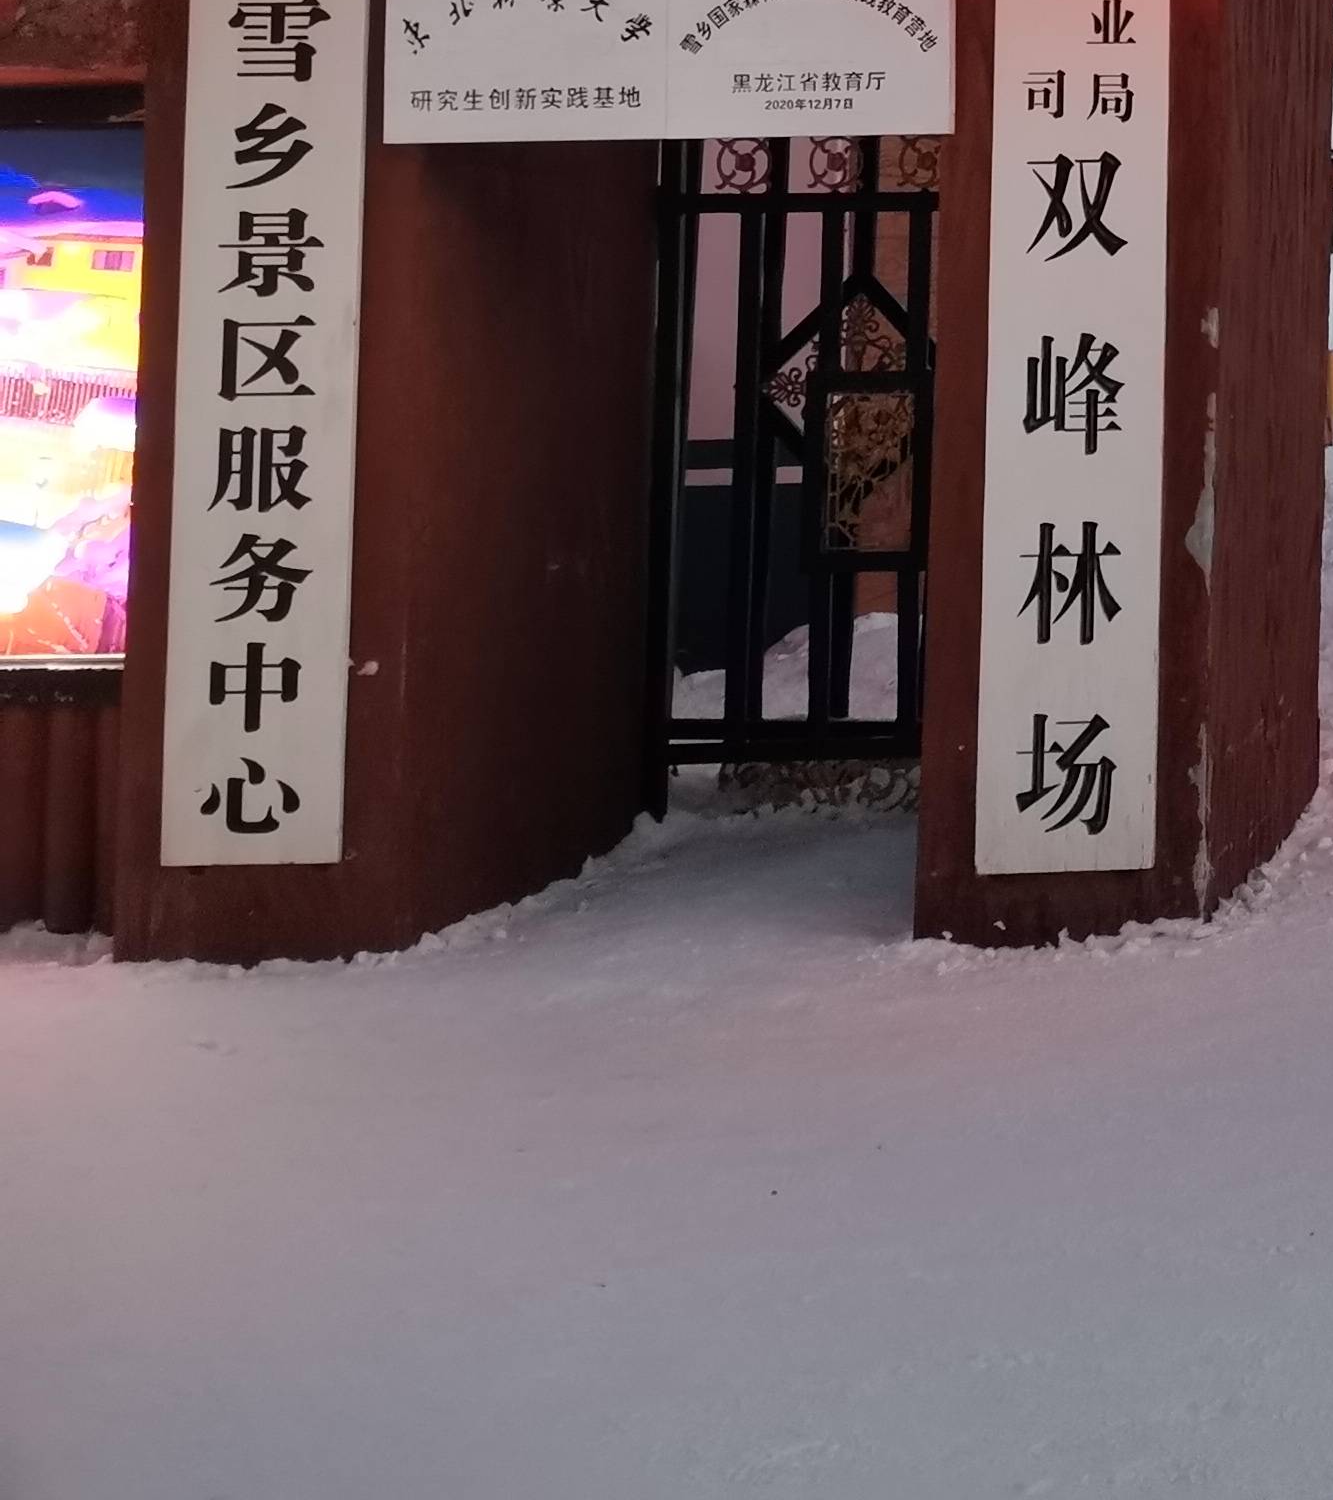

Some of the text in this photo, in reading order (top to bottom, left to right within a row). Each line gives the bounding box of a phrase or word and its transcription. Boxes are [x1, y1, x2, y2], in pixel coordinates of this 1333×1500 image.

[732, 72, 887, 94] 黑龙江省教育厅
[410, 85, 642, 112] 研究生创新实践基地
[764, 98, 854, 111] 2020年12月7日
[1015, 151, 1128, 835] 双峰林场
